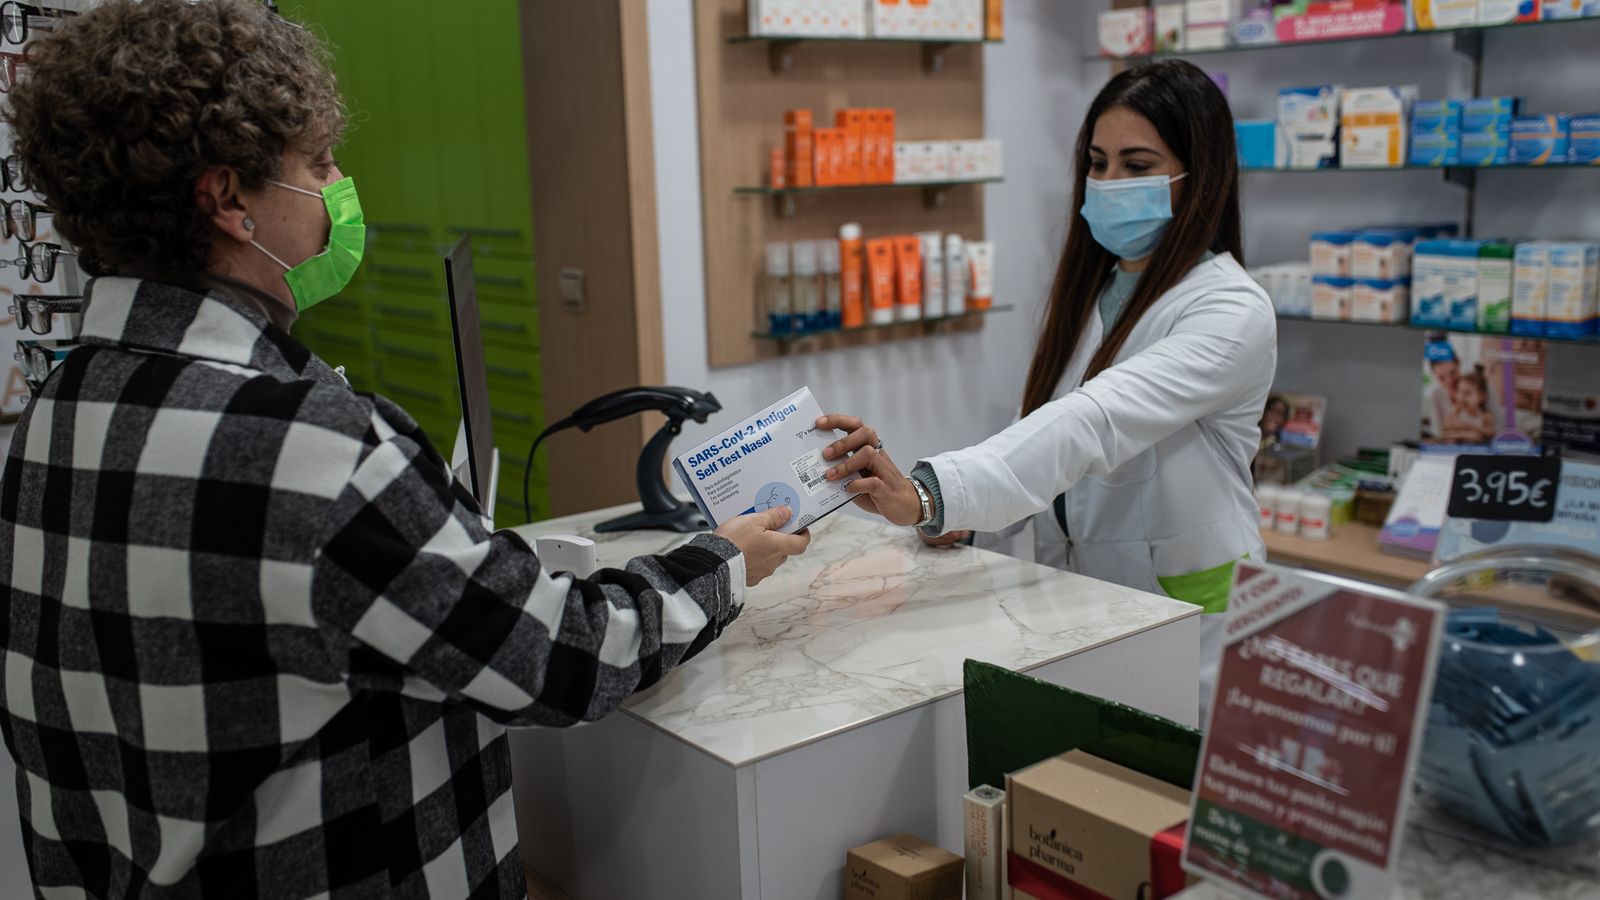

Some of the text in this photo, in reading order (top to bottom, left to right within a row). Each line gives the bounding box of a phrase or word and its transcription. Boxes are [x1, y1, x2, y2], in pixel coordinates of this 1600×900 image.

[688, 425, 756, 468] SARS-CoV-2
[756, 403, 797, 430] Antigen
[696, 432, 772, 480] Self Test Nasal
[1028, 843, 1076, 876] pharma
